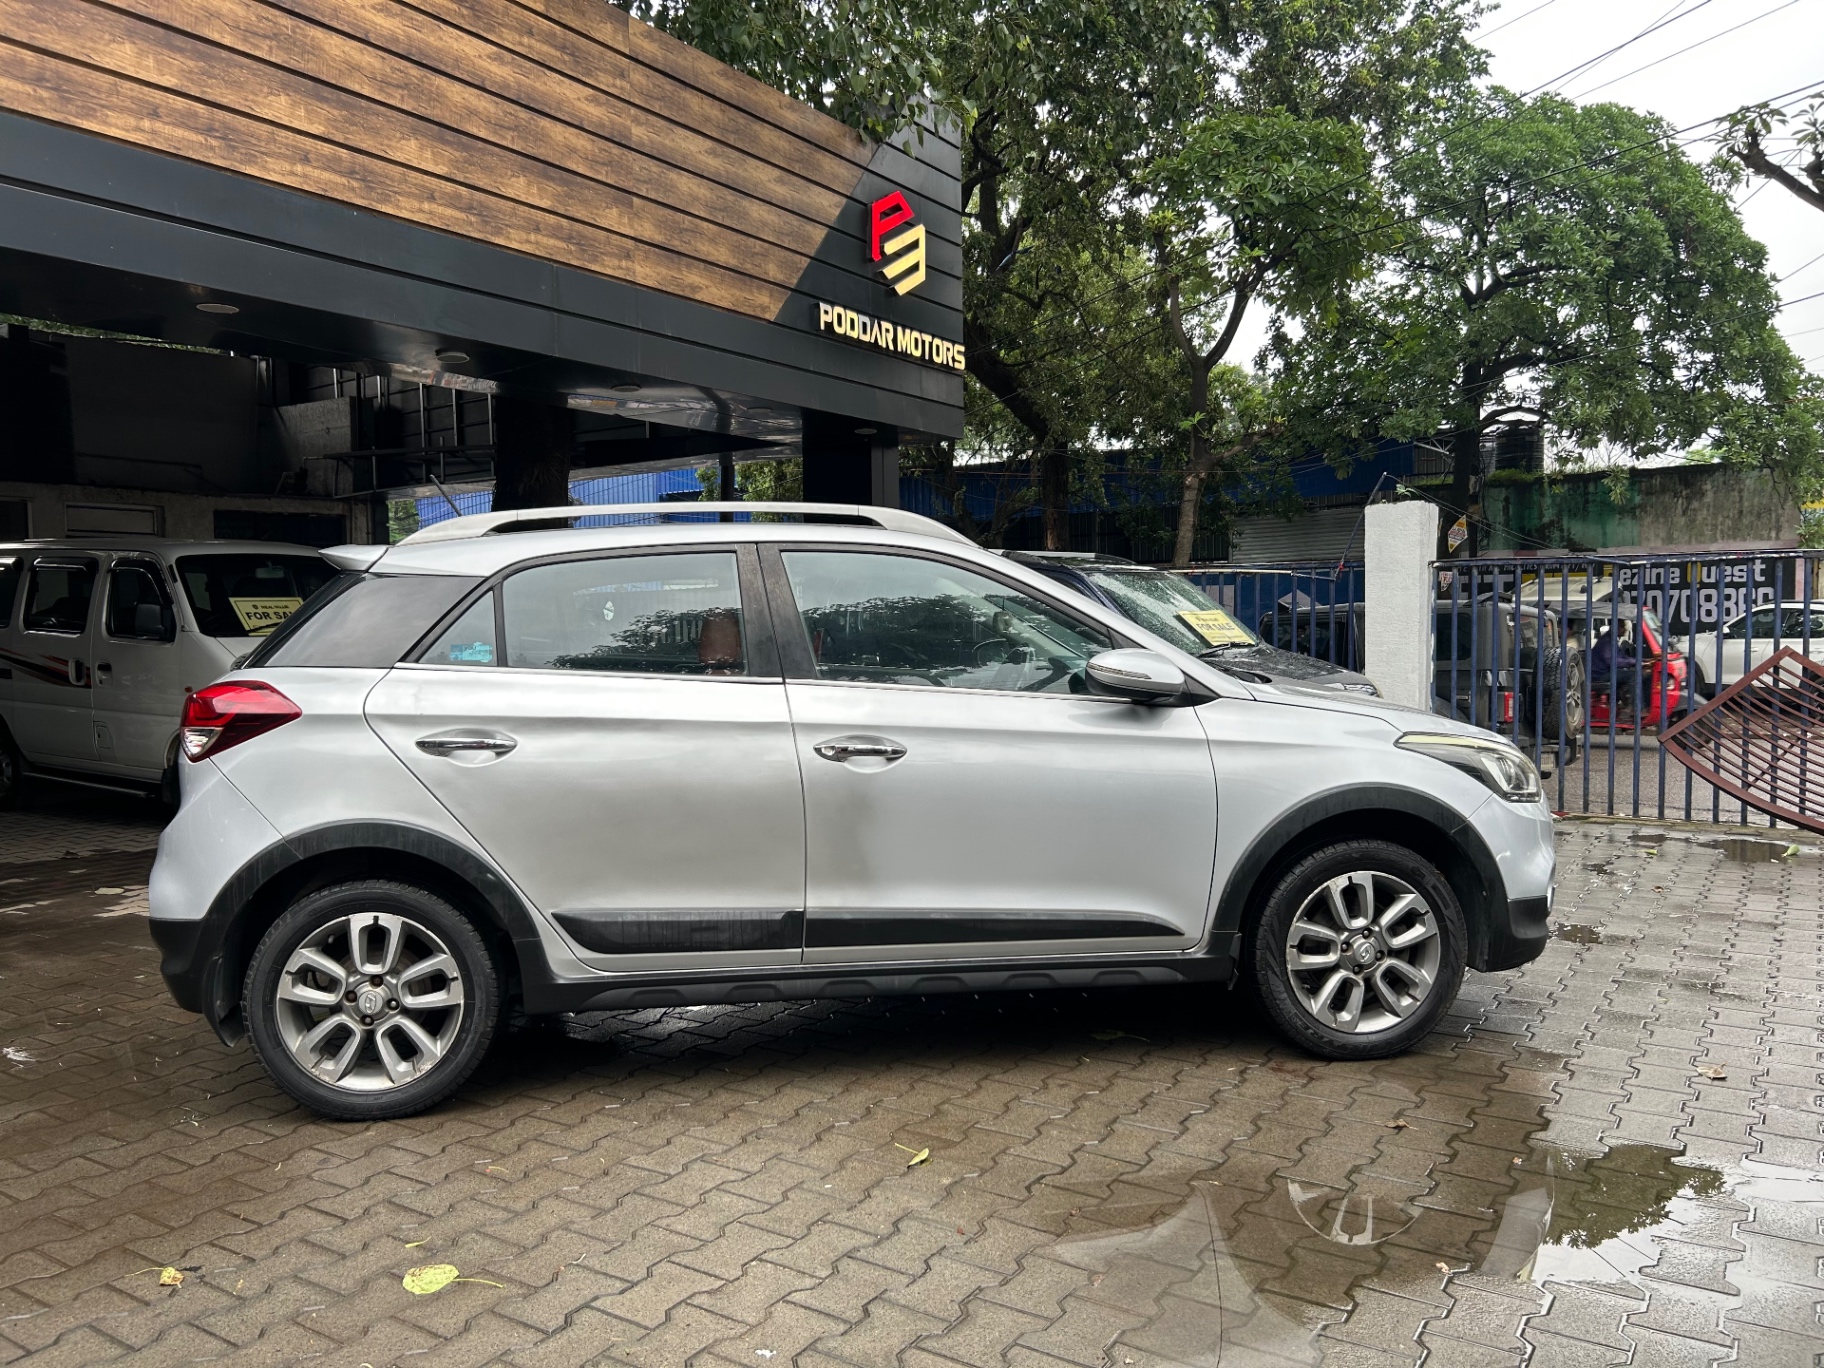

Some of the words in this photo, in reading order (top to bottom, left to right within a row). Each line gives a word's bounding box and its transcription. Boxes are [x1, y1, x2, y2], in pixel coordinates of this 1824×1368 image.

[819, 301, 895, 351] PODDAR
[897, 326, 966, 370] MOTORS
[1686, 559, 1766, 588] Quest
[245, 611, 273, 621] FOR
[273, 611, 293, 620] SA
[1196, 623, 1216, 631] FOR
[1212, 622, 1236, 631] SALE
